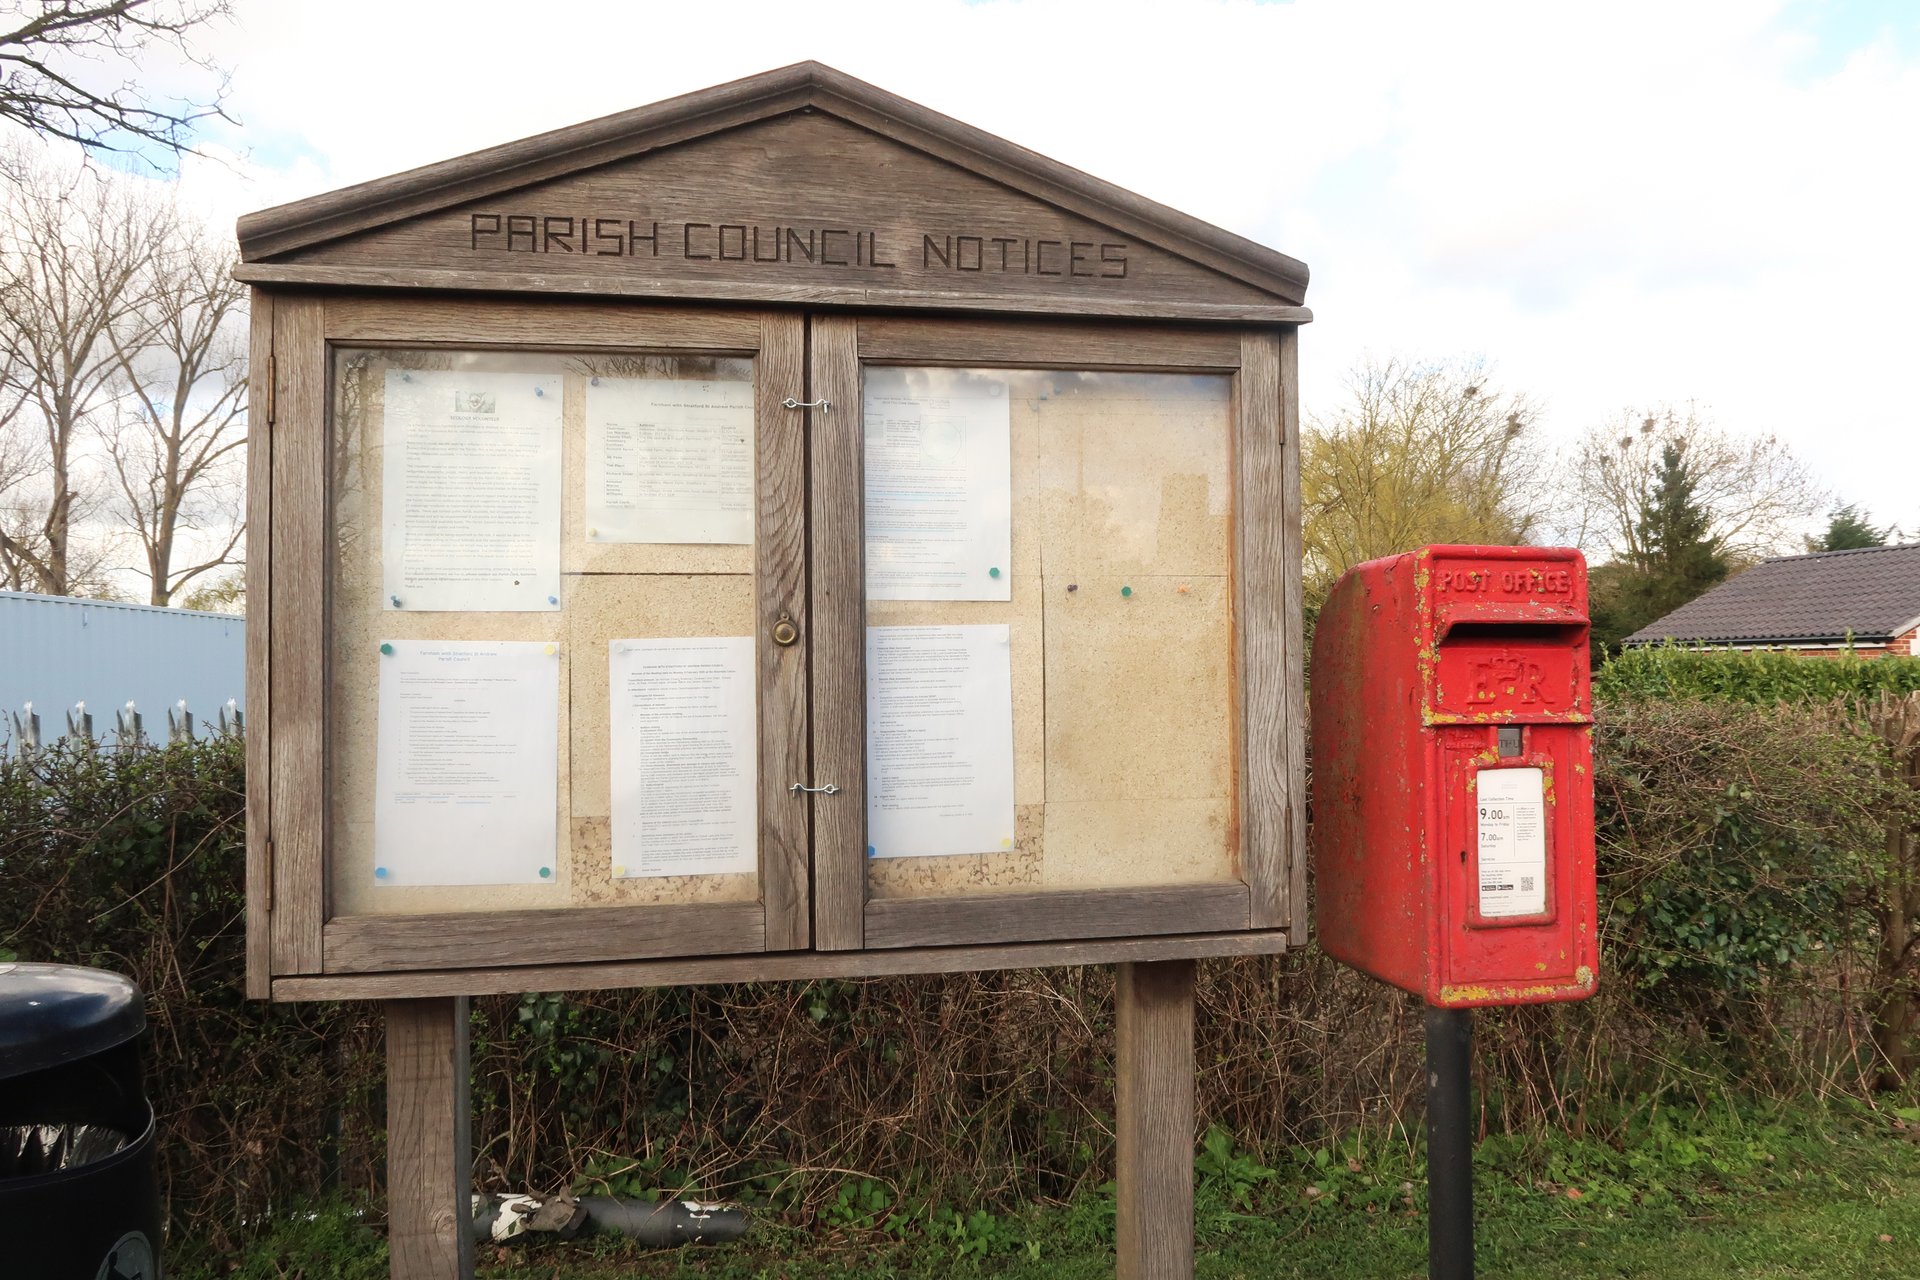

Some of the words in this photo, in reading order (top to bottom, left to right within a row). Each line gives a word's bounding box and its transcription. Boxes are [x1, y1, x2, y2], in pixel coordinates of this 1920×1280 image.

[471, 213, 659, 257] PARISH
[684, 222, 896, 268] COUNCIL
[923, 234, 1128, 279] NOTICES
[1440, 569, 1490, 592] POST
[1502, 570, 1571, 593] OFFICE
